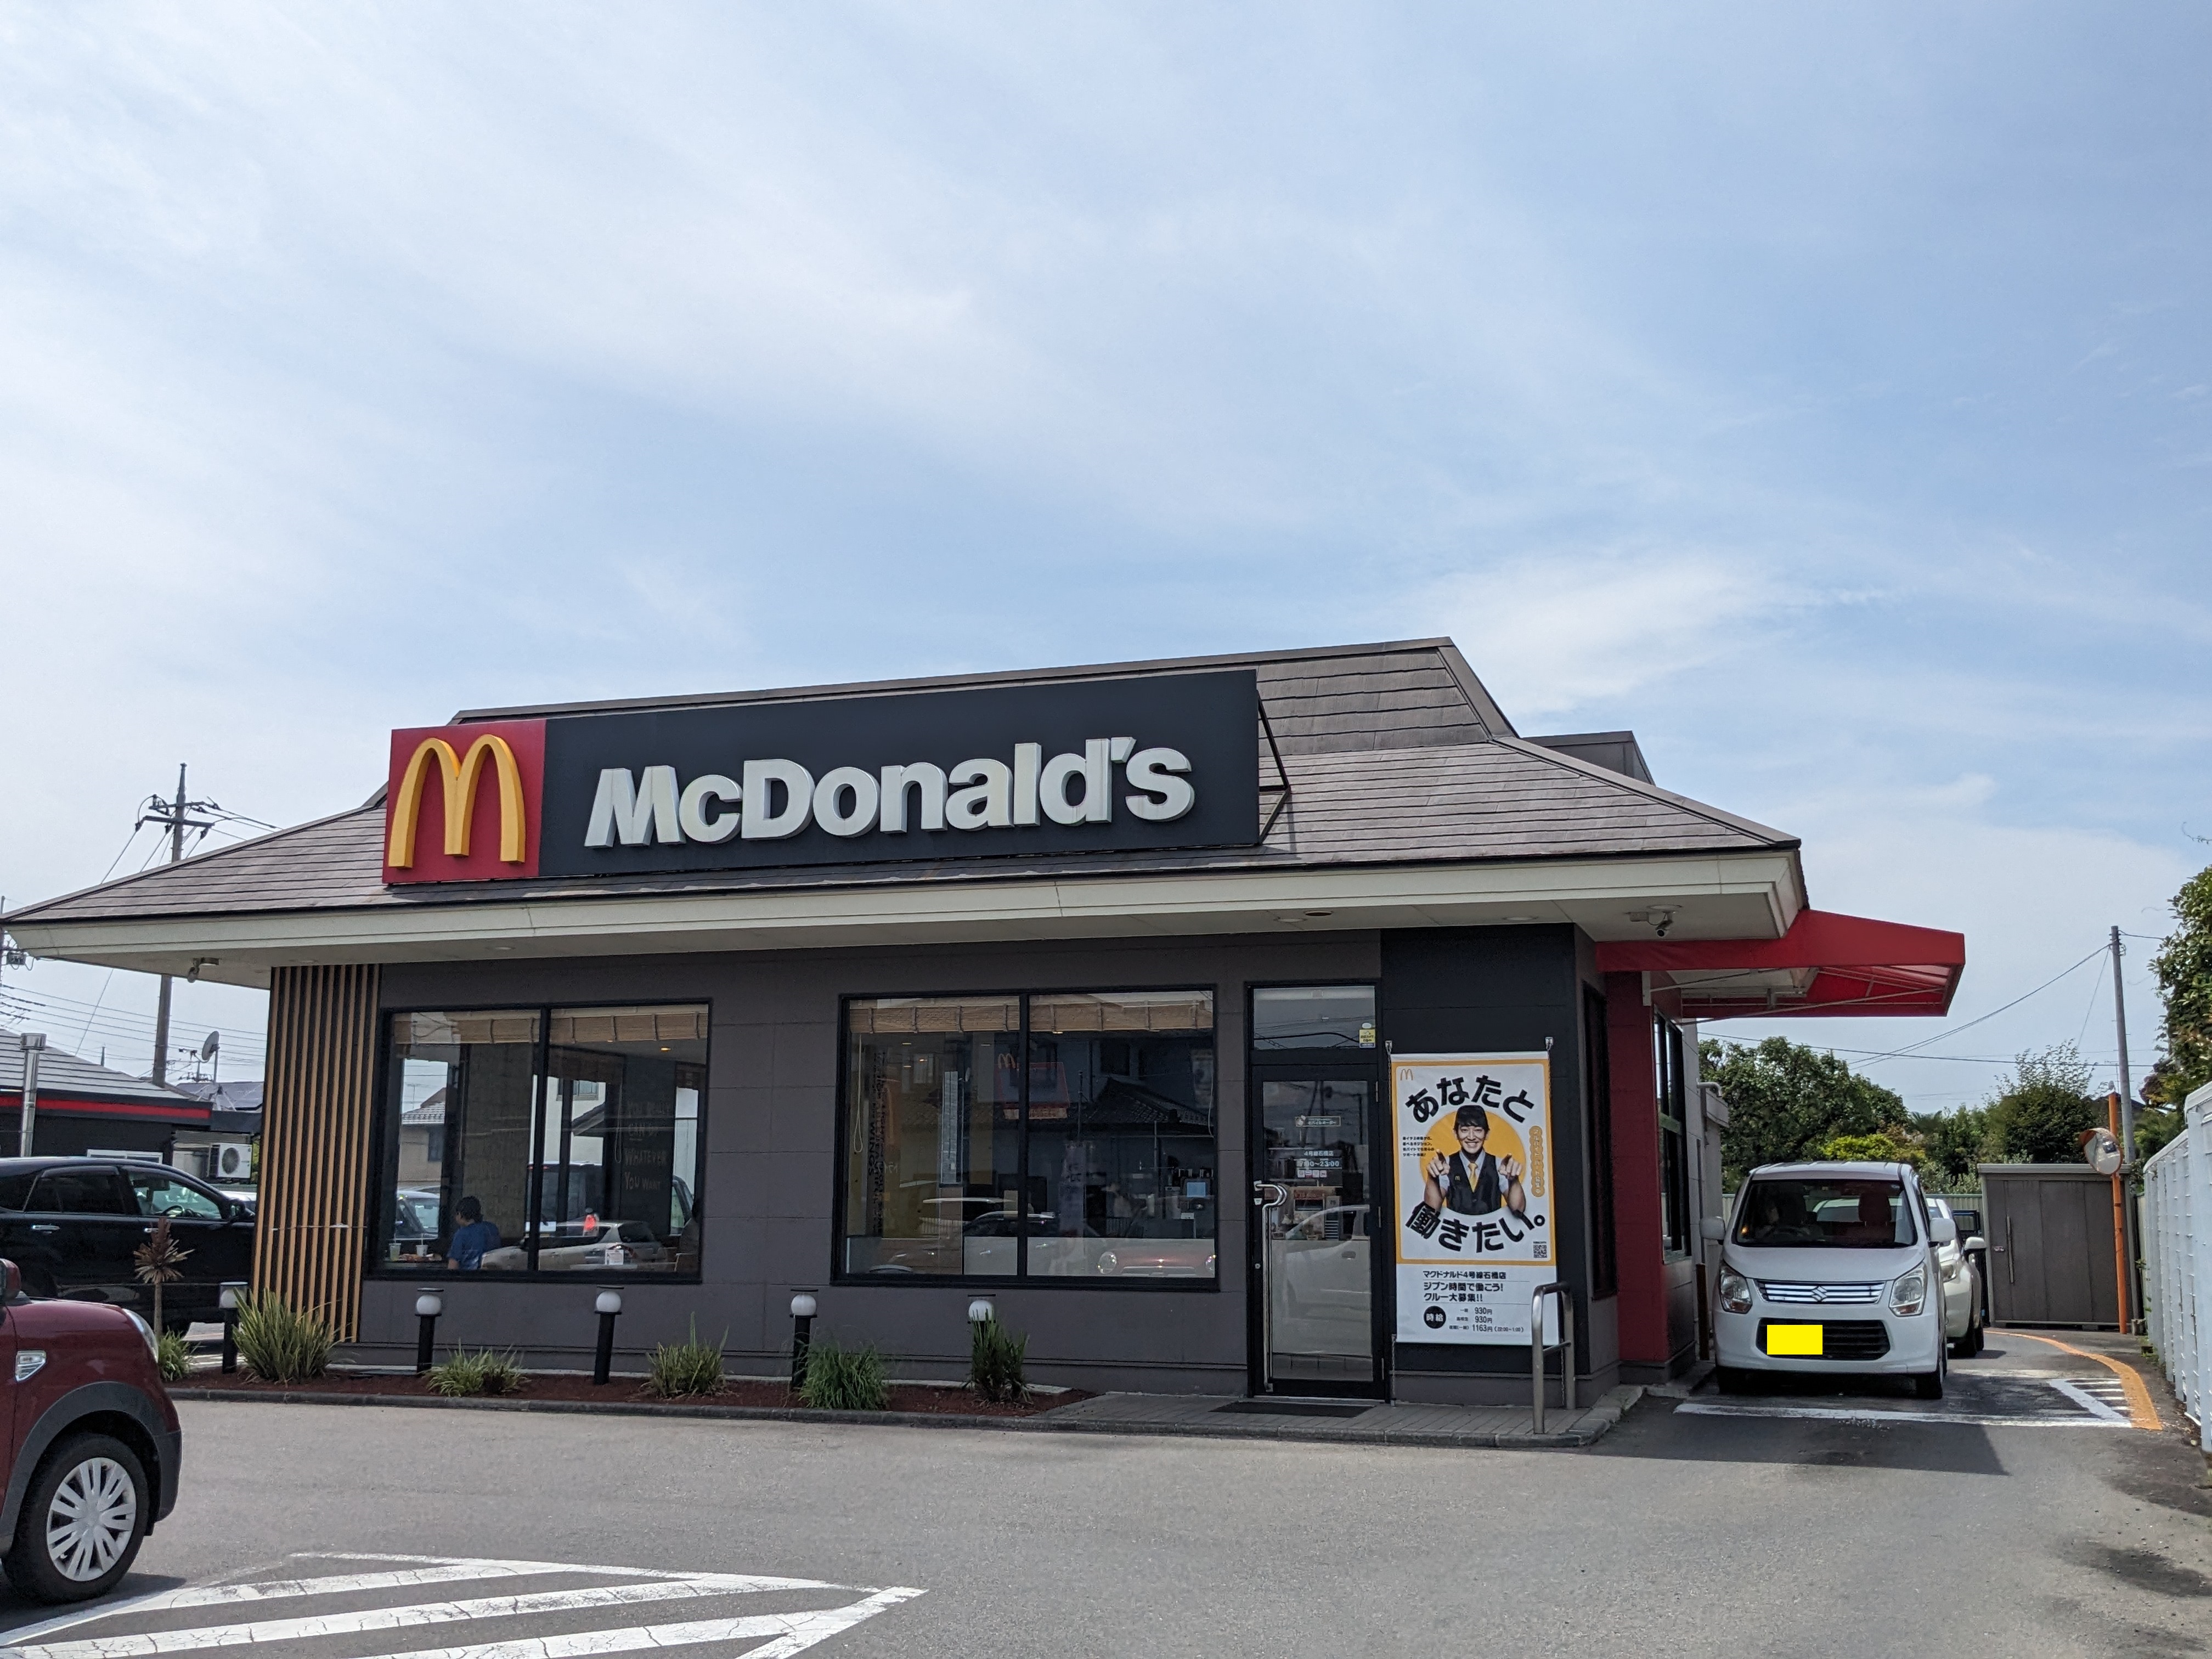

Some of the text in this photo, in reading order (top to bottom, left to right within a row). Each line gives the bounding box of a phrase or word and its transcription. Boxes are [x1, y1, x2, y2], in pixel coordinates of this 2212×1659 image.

[584, 736, 1195, 849] McDonald's
[1404, 1075, 1534, 1124] あなたと
[1405, 1201, 1545, 1253] 働きたい。
[1423, 1271, 1506, 1279] マクドナルド4号線石橋店
[1424, 1282, 1503, 1292] ジブン時間で働こう!
[1424, 1293, 1483, 1302] クルー大募集!!
[1474, 1307, 1492, 1315] 930円
[1426, 1313, 1444, 1322] 時給
